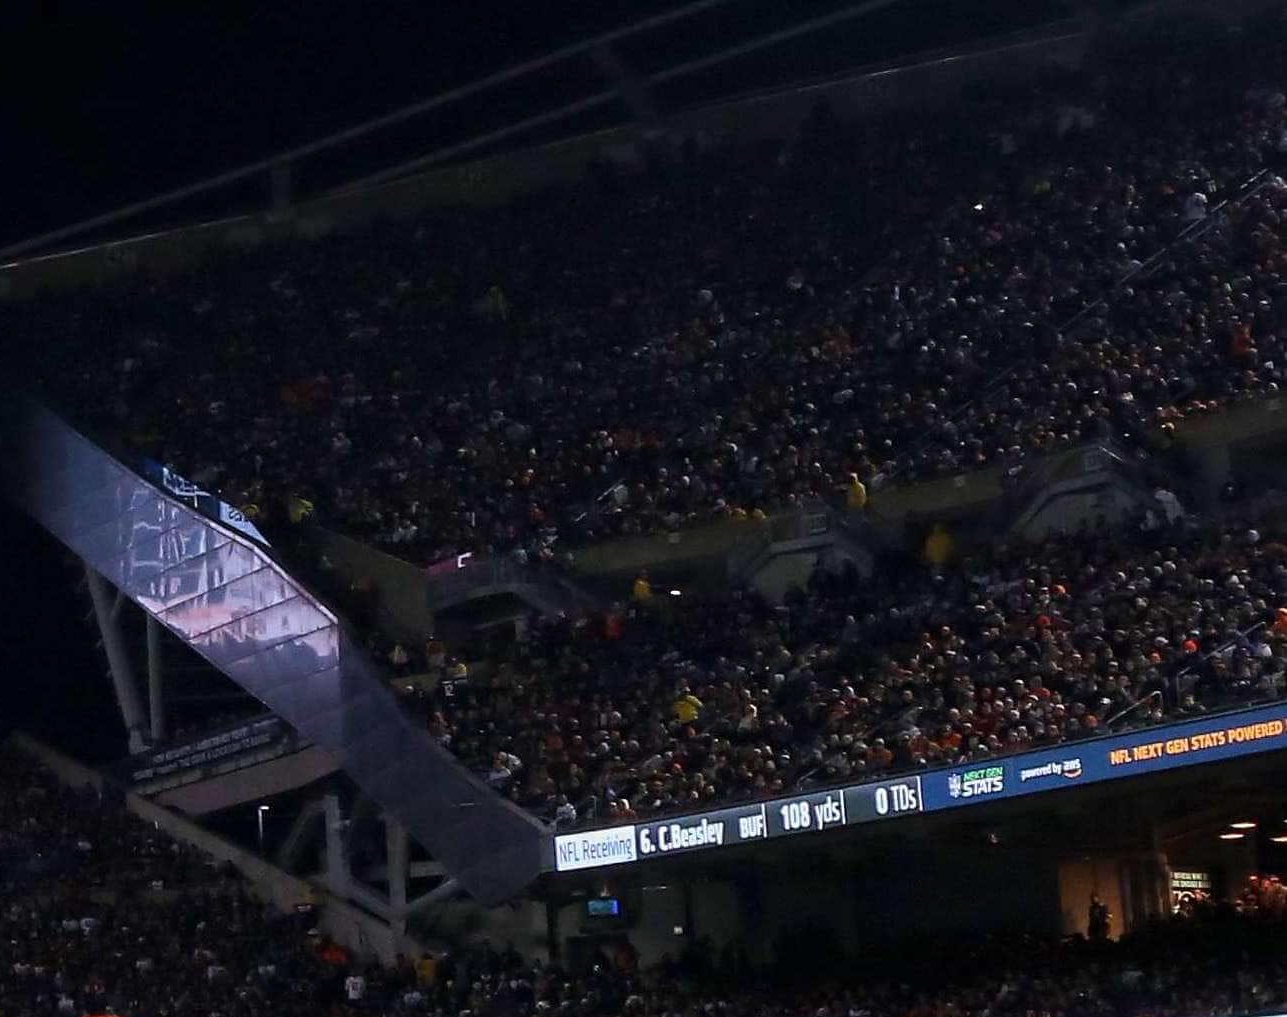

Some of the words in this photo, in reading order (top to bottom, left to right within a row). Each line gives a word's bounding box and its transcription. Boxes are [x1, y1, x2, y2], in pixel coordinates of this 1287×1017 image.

[1110, 750, 1132, 765] NFL
[1133, 743, 1164, 761] NEXT
[1166, 738, 1189, 754] GEN
[1191, 731, 1226, 750] STATS
[1228, 720, 1283, 743] POWERED
[963, 769, 986, 782] NEXT
[986, 767, 1003, 777] GEN
[1021, 764, 1052, 782] powered
[1052, 762, 1062, 775] by
[962, 777, 1003, 798] STATS
[558, 841, 581, 867] NFL
[582, 836, 633, 861] Receiving
[640, 829, 656, 854] 6.
[658, 820, 724, 852] C.Beasley
[739, 815, 764, 839] BUF
[780, 802, 810, 831] 108
[815, 796, 841, 830] yds
[876, 786, 890, 815] 0
[891, 784, 917, 812] TDs
